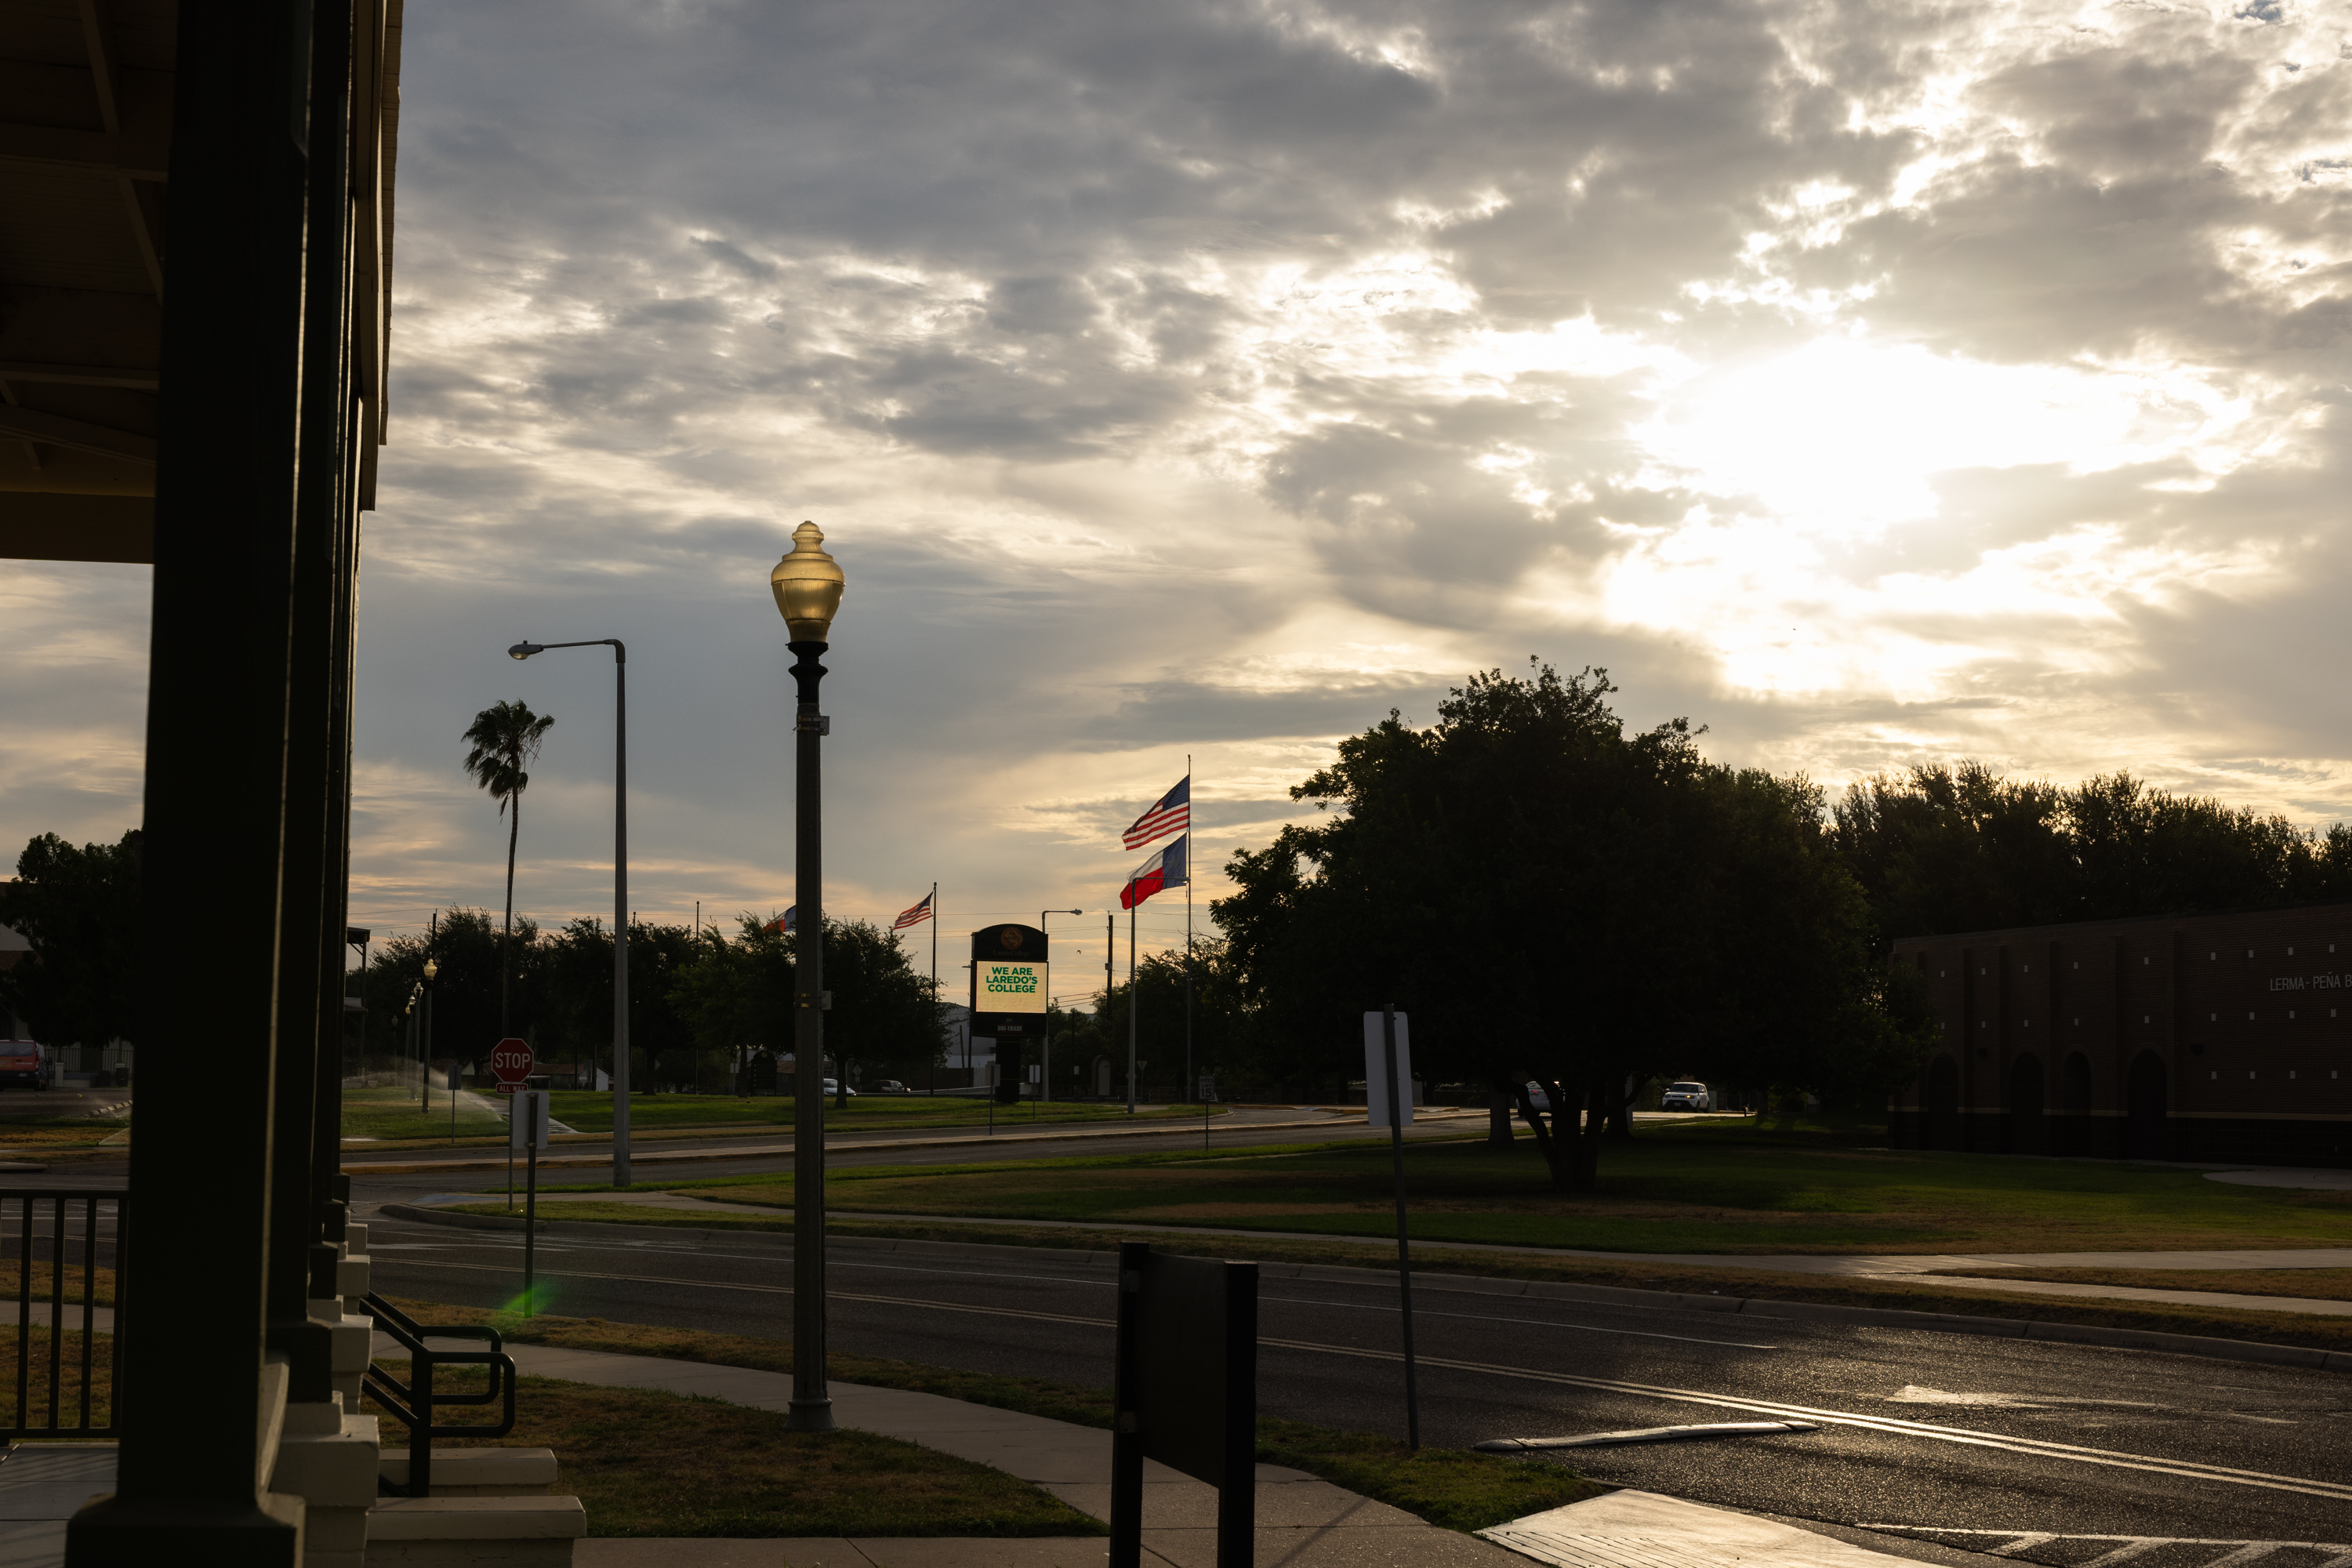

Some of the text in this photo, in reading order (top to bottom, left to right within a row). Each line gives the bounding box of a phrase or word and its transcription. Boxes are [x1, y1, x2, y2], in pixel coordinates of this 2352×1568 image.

[985, 975, 1038, 984] LAREDO'S
[988, 984, 1036, 993] COLLEGE
[495, 1051, 531, 1069] STOP
[1201, 1088, 1212, 1098] 15
